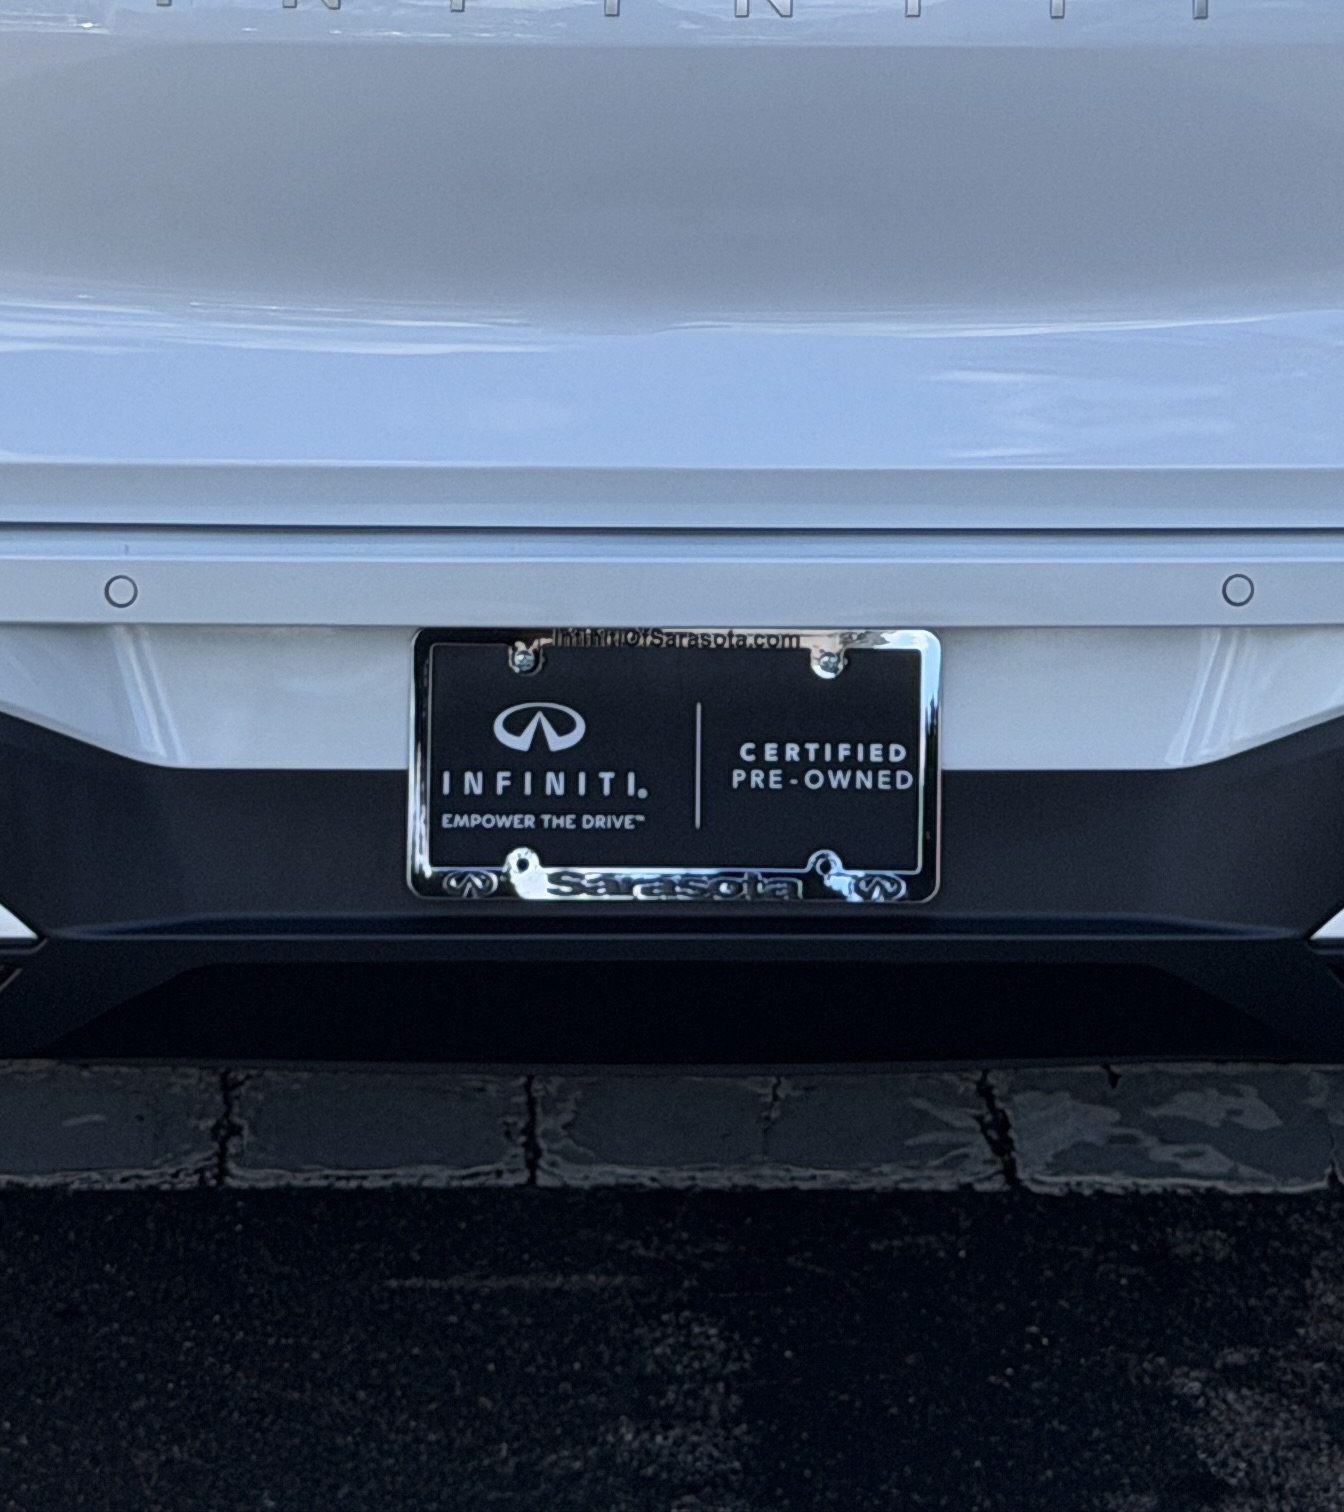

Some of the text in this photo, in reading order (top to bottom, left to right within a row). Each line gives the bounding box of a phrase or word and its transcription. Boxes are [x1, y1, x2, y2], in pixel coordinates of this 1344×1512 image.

[739, 742, 907, 762] CERTIFIED
[732, 769, 914, 789] PRE-OWNED
[442, 813, 536, 829] EMPOWER
[540, 814, 576, 829] THE
[546, 871, 804, 900] Sarasota
